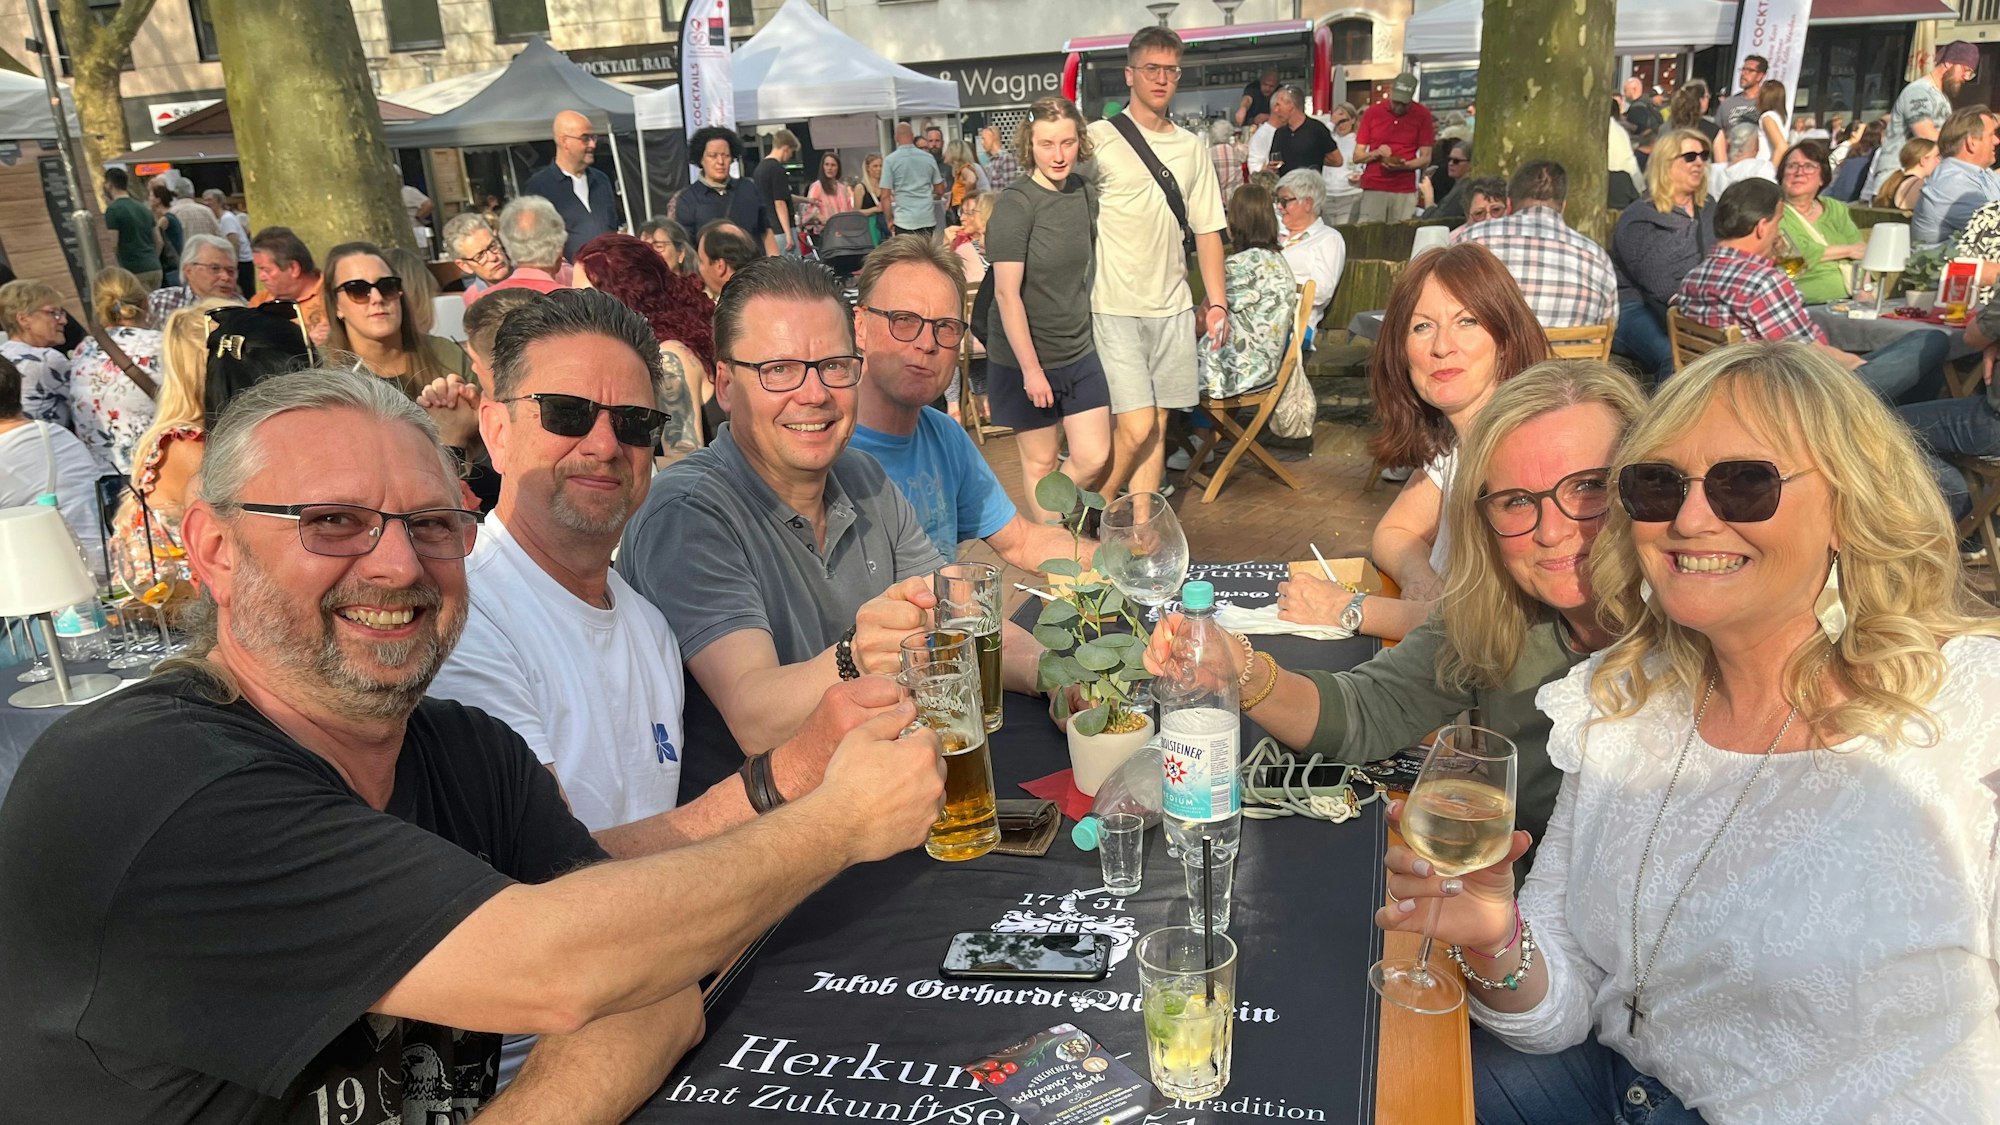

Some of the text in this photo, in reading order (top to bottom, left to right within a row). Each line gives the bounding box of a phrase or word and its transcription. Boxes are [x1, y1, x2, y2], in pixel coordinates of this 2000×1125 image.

[1753, 0, 1769, 47] COCKT
[641, 56, 673, 71] BAR
[690, 63, 703, 127] COCKTAILS
[1018, 893, 1126, 911] 17 51
[804, 971, 899, 996] Jakob
[906, 978, 1067, 1008] Gerhardt
[719, 1033, 984, 1092] Herkun
[1030, 1063, 1072, 1086] FRECHENER
[665, 1075, 741, 1105] hat
[748, 1084, 943, 1122] Zukunft
[1010, 1071, 1087, 1105] Schlemmer- &
[1039, 1073, 1106, 1107] Abend-Markt
